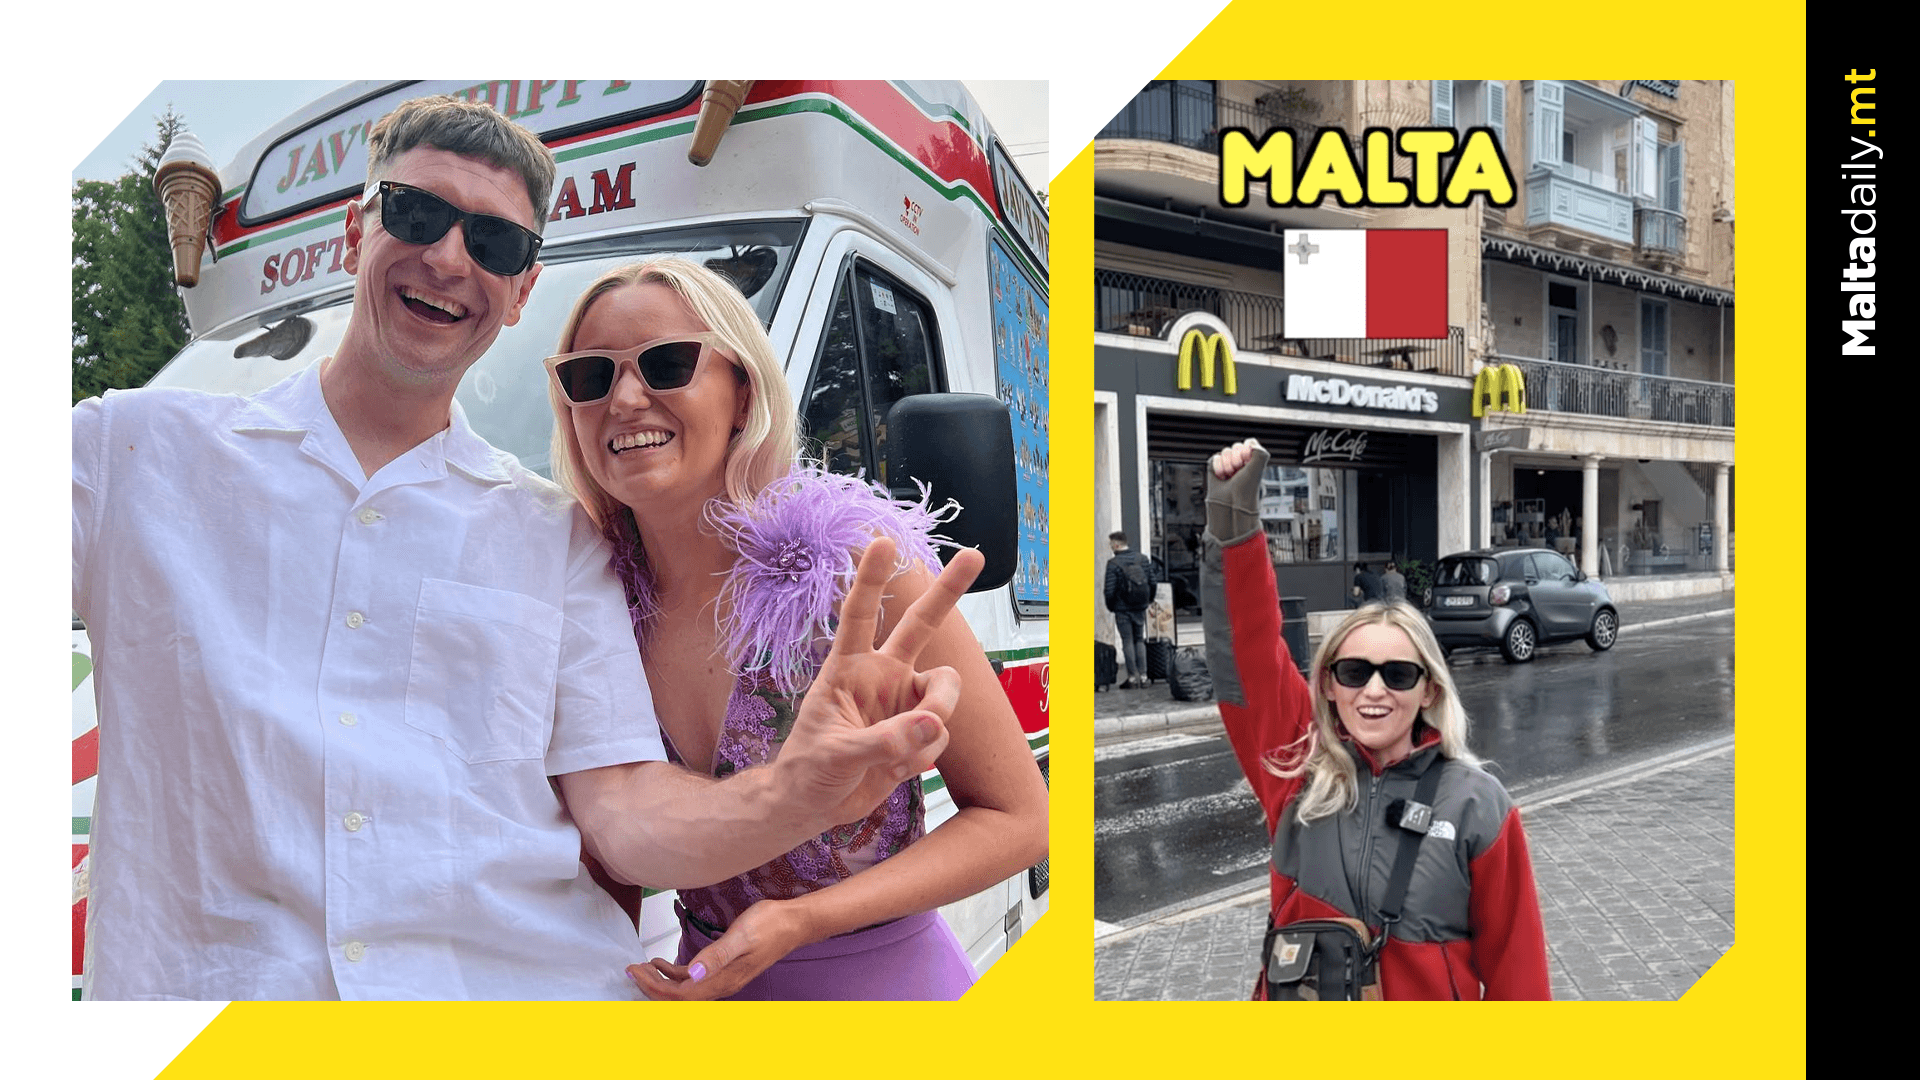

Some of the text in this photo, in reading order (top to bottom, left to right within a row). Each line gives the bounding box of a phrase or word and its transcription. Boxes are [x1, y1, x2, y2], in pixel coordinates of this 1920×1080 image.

[277, 119, 373, 194] JAV'
[261, 235, 345, 295] SOFT
[1285, 374, 1440, 414] McDonald's
